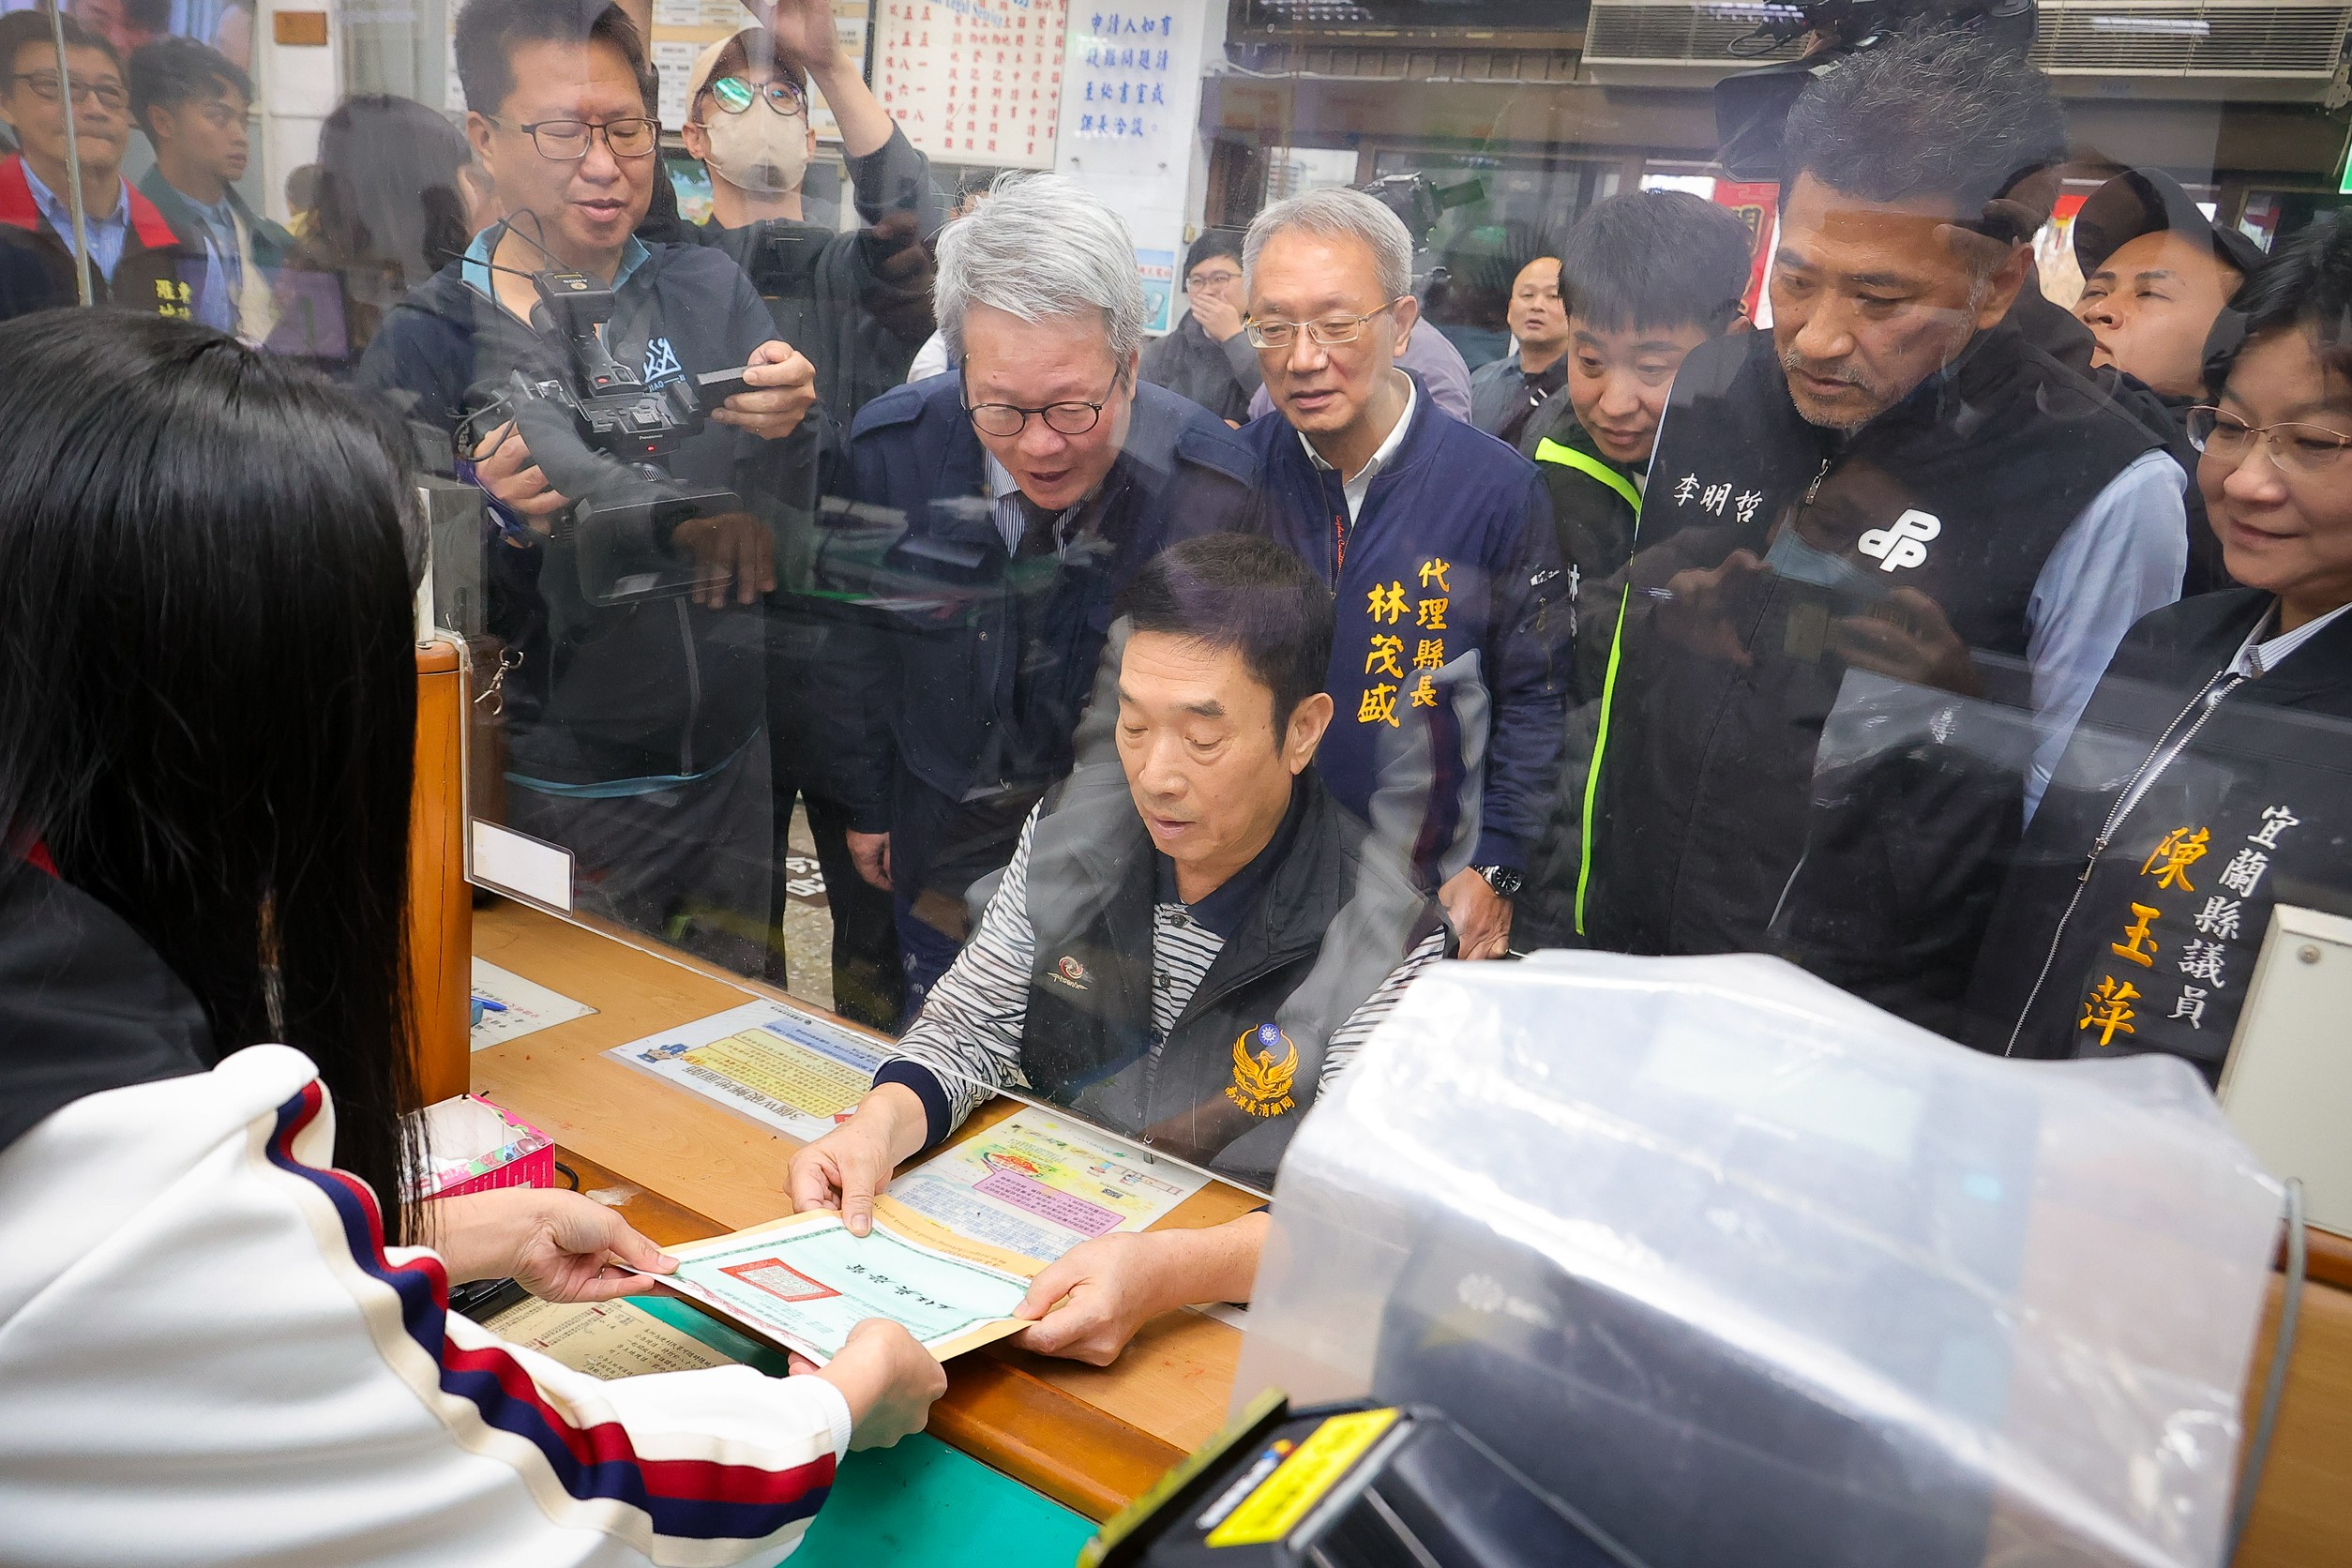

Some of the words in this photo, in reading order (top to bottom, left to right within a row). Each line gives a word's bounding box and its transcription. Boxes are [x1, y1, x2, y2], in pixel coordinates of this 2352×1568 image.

[1673, 472, 1764, 523] 李明哲
[1356, 579, 1411, 730] 林茂盛
[1409, 557, 1452, 708] 代理縣長
[2078, 825, 2212, 1048] 陳玉萍
[2166, 804, 2301, 1031] 宜蘭縣議員
